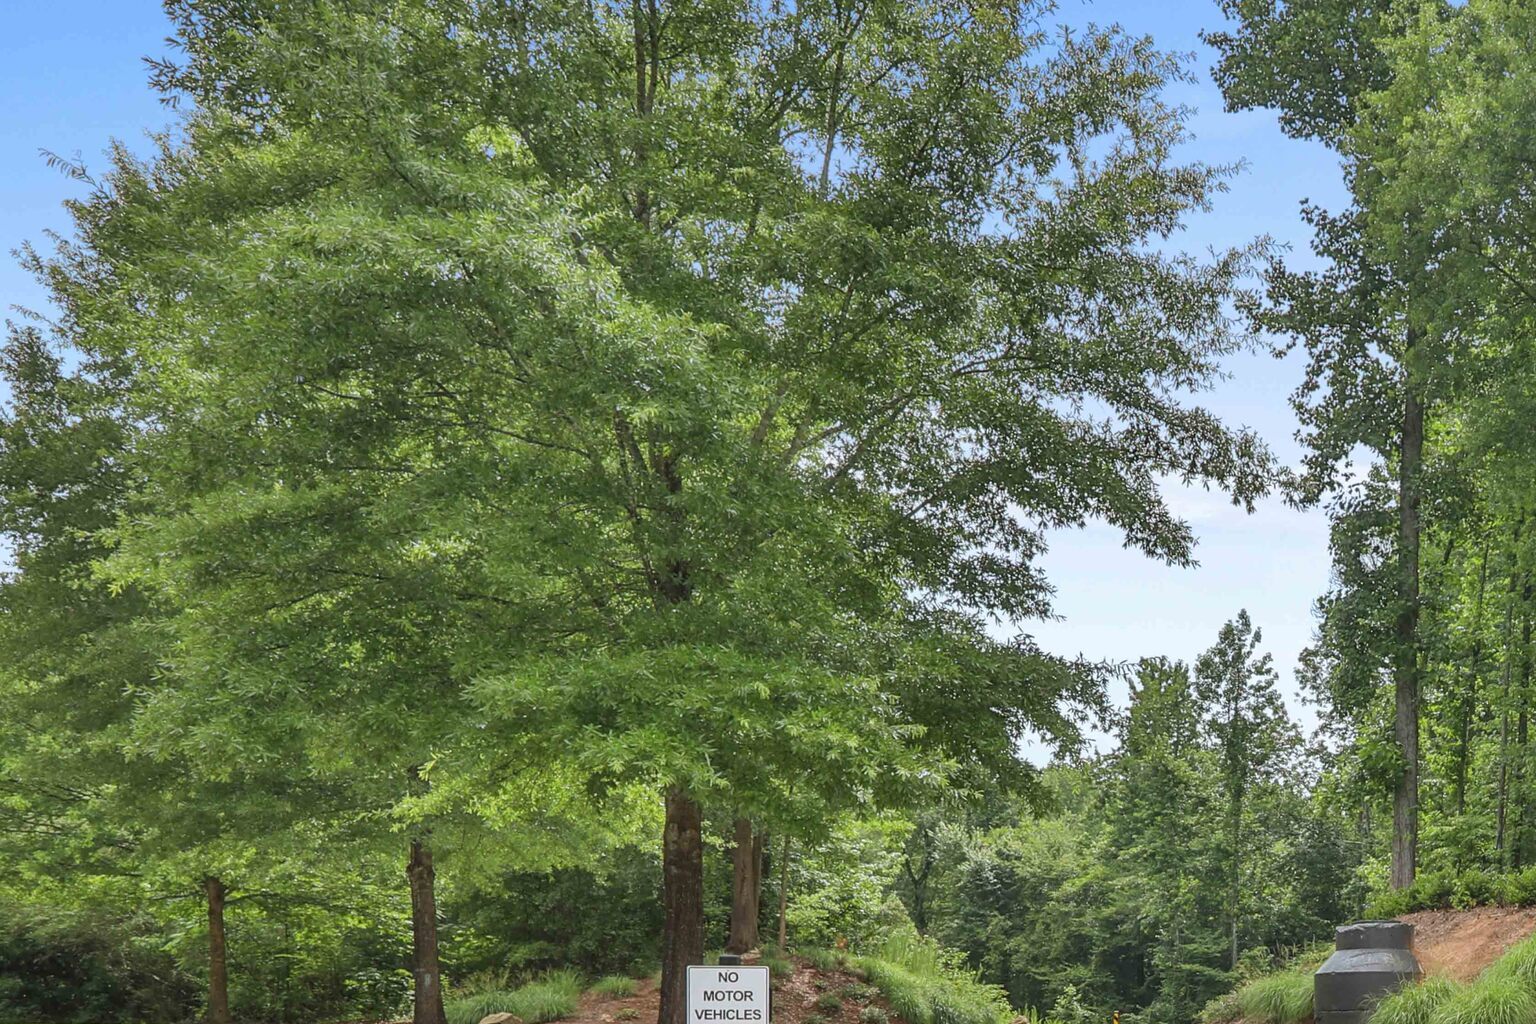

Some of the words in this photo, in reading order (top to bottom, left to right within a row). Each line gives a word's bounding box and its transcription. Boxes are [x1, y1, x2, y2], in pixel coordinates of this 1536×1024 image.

[718, 971, 739, 983] NO
[703, 990, 754, 1002] MOTOR
[695, 1009, 762, 1020] VEHICLES
